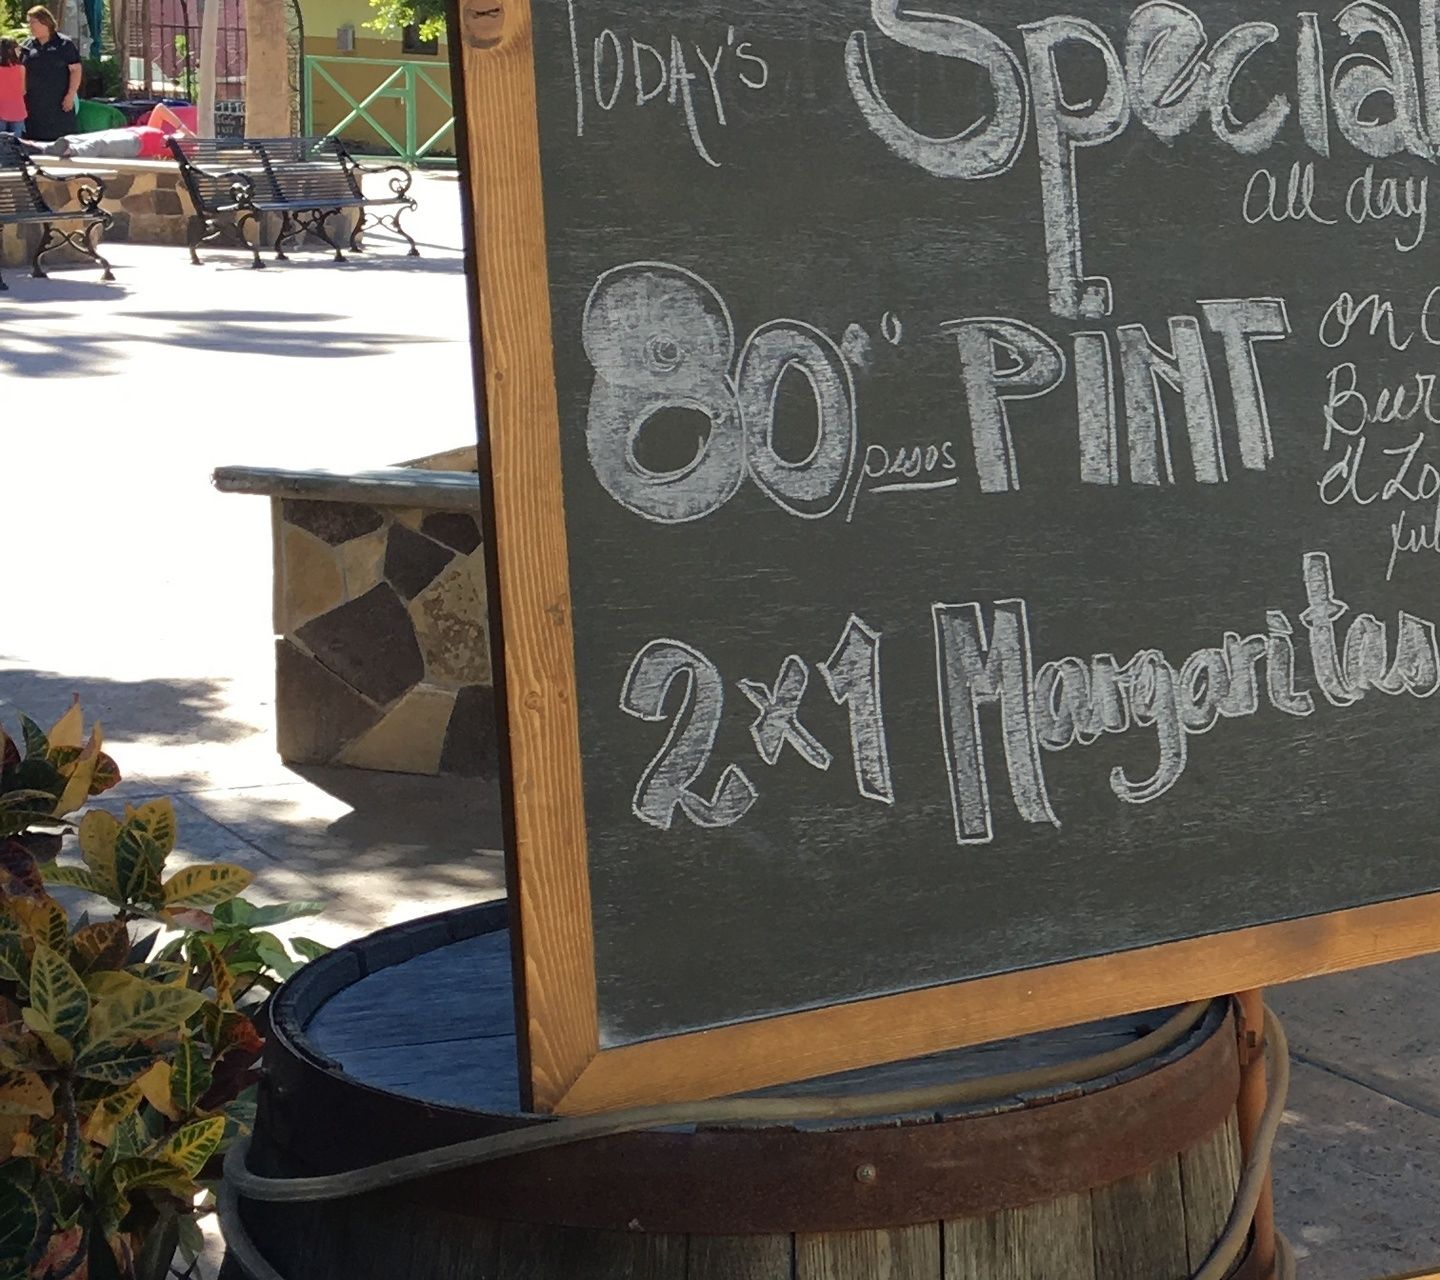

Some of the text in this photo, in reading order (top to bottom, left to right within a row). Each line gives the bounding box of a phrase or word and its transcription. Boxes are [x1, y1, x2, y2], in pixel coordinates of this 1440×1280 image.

[1242, 161, 1429, 252] all day
[1318, 292, 1415, 351] on
[940, 295, 1292, 493] PINT
